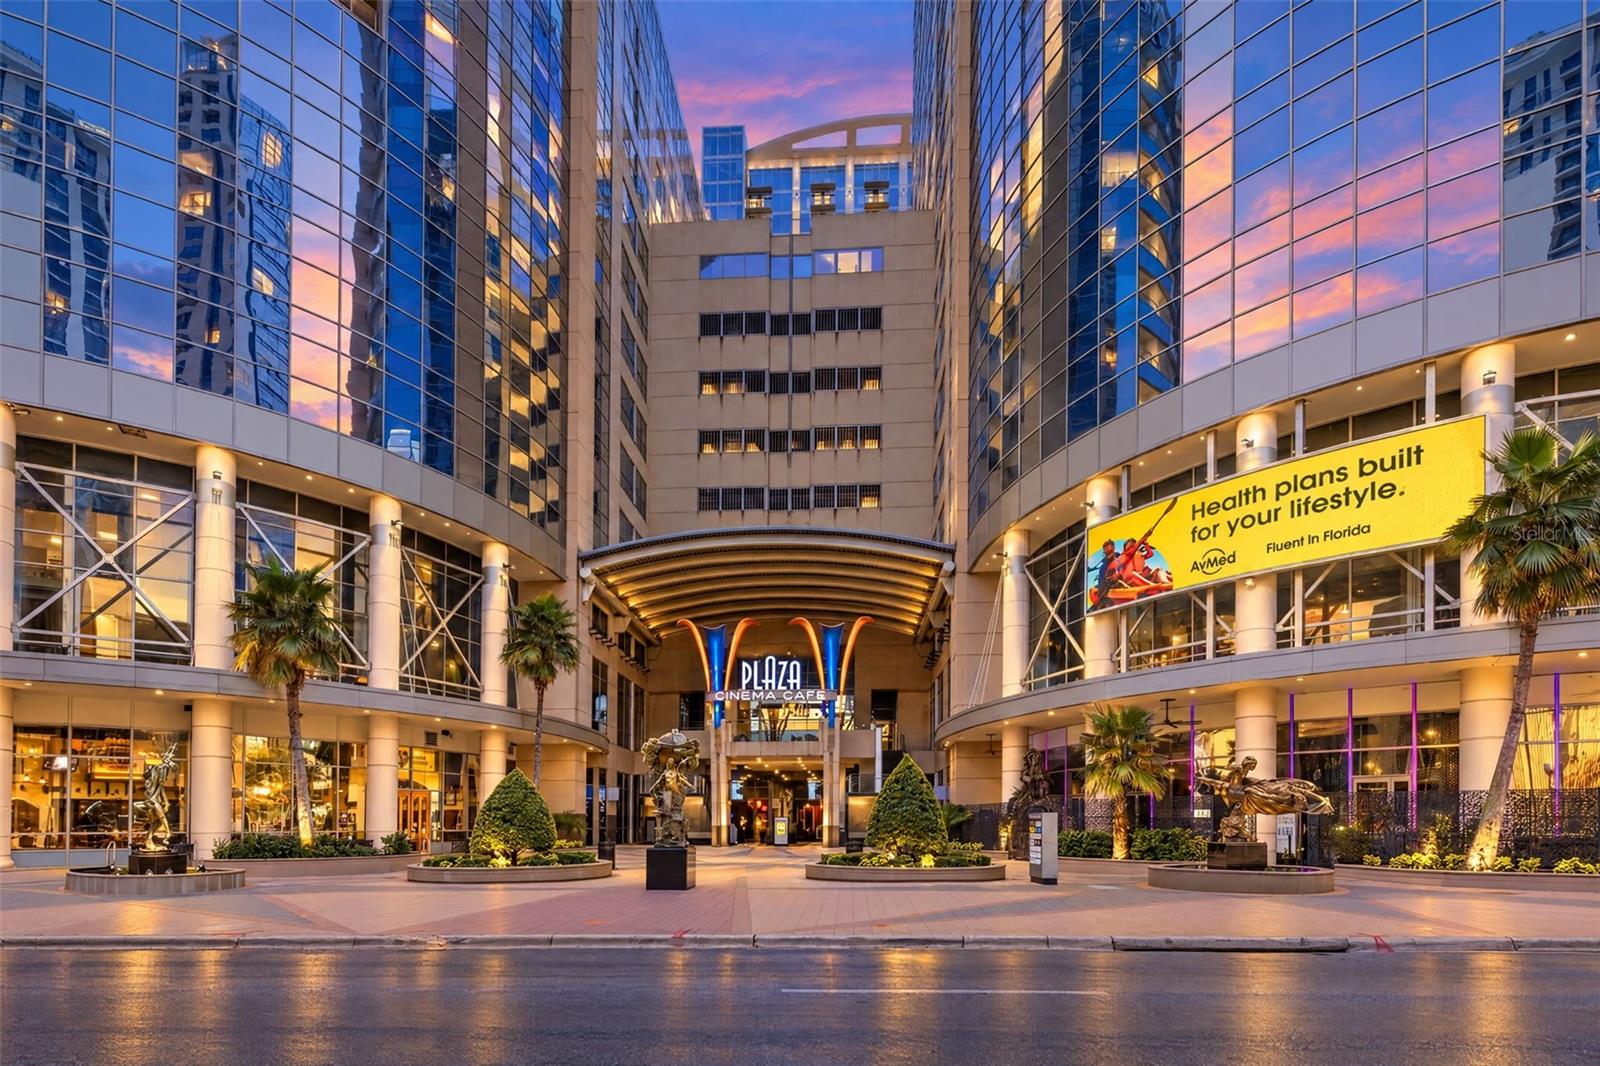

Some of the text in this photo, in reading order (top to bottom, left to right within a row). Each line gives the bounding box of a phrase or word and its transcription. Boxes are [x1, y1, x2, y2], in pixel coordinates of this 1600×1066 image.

[1191, 444, 1424, 521] Health plans built
[1191, 481, 1406, 543] for your lifestyle.
[1265, 524, 1371, 554] Fluent In Florida
[1190, 550, 1237, 573] AvMed
[741, 655, 801, 690] PLAZA
[714, 690, 826, 701] CINEMA CAFE
